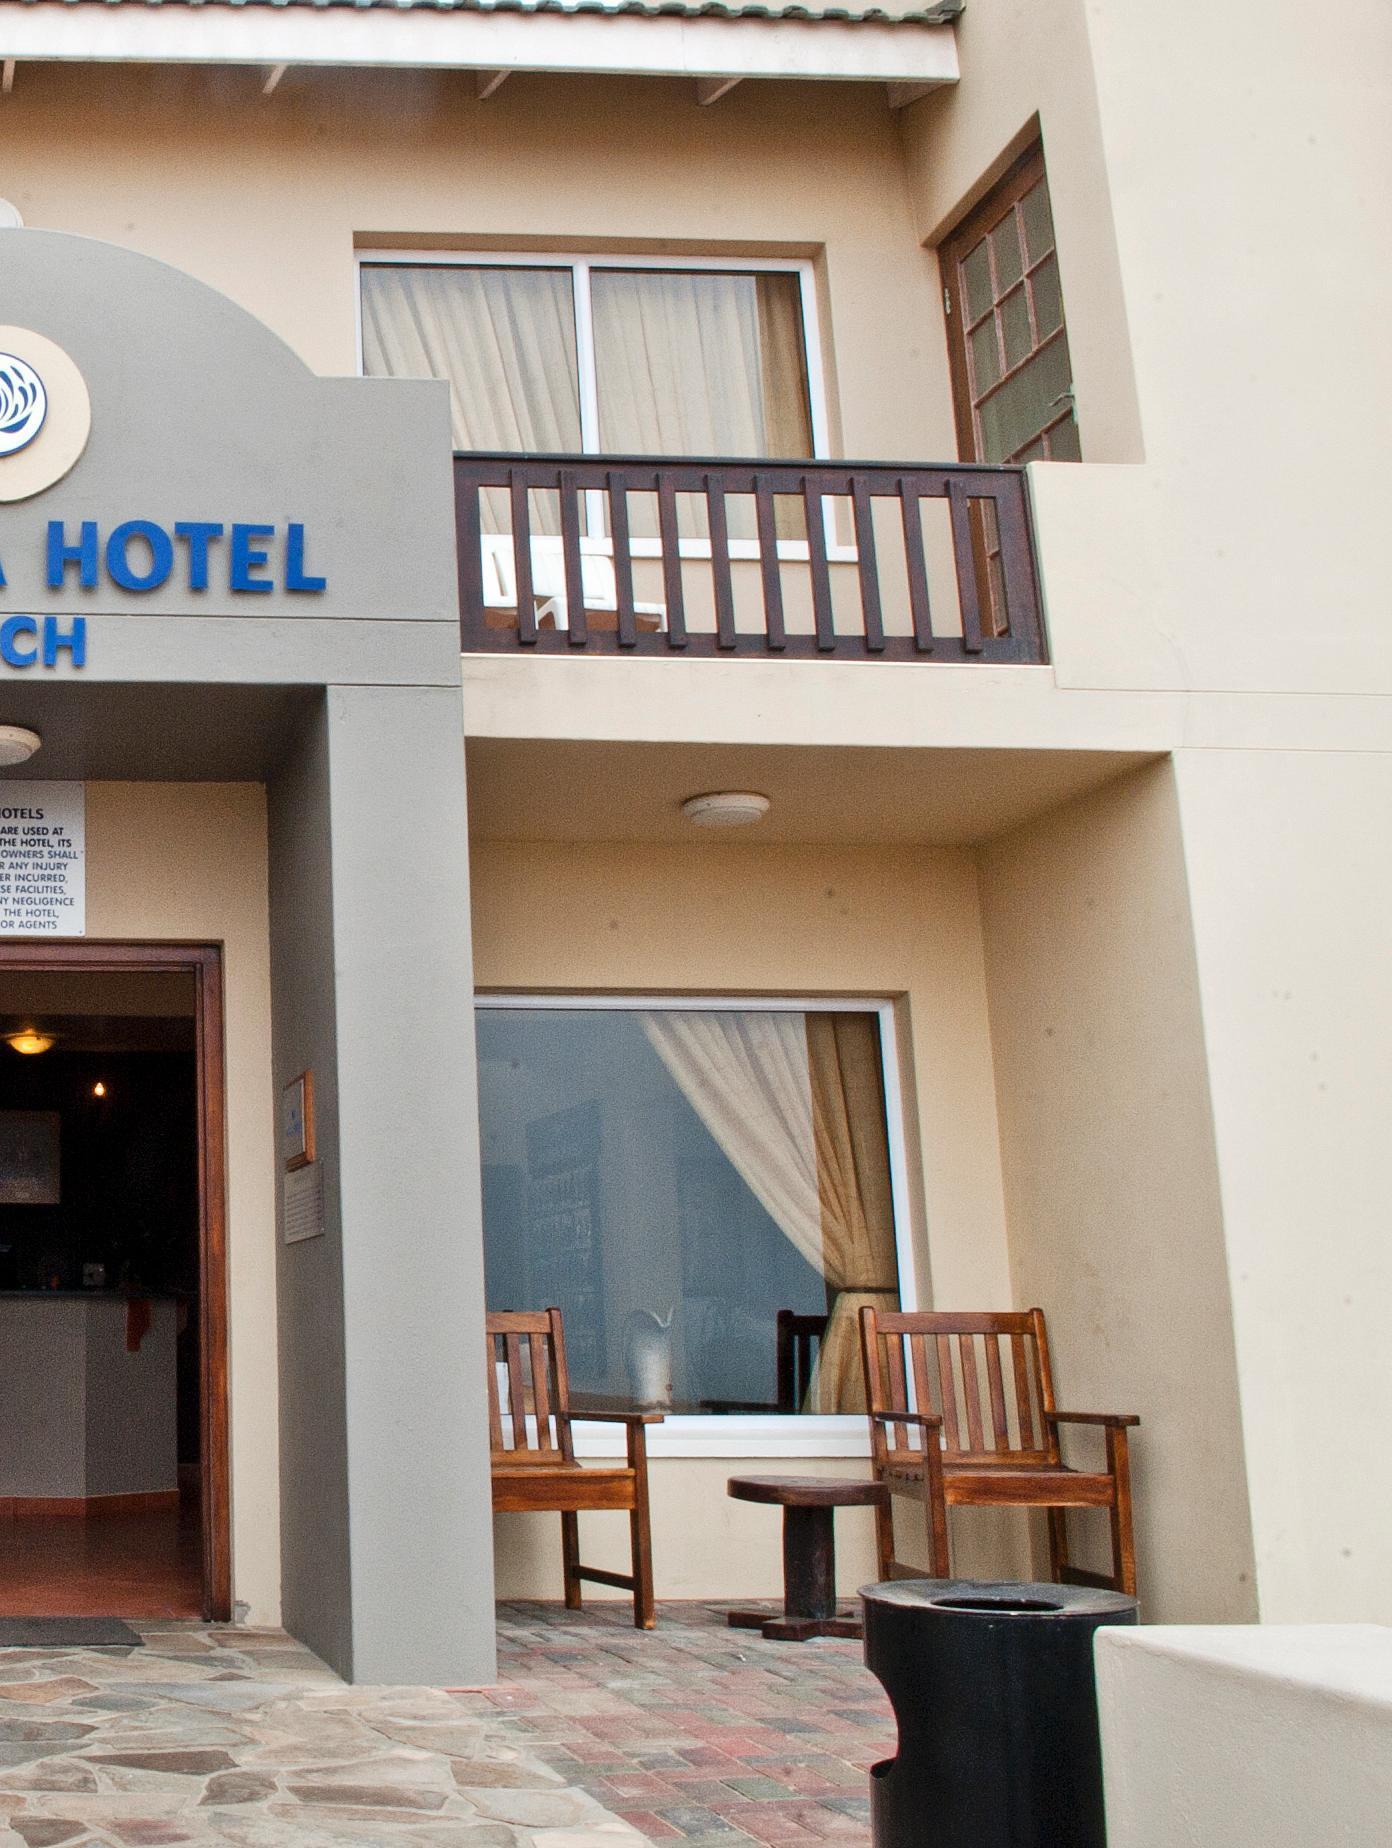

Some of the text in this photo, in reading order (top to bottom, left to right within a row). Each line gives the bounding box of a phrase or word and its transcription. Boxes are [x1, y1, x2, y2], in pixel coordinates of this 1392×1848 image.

[46, 519, 327, 592] HOTEL
[0, 826, 19, 835] ARE
[22, 826, 49, 836] USED
[52, 827, 64, 836] AT
[57, 838, 72, 848] ITS
[0, 849, 44, 859] OWNERS
[47, 850, 78, 860] SHALL
[8, 861, 29, 870] ANY
[32, 862, 68, 871] INJURY
[12, 897, 75, 906] NEGLIGENCE
[3, 908, 22, 917] THE
[0, 920, 15, 929] OR
[18, 920, 57, 929] AGENTS
